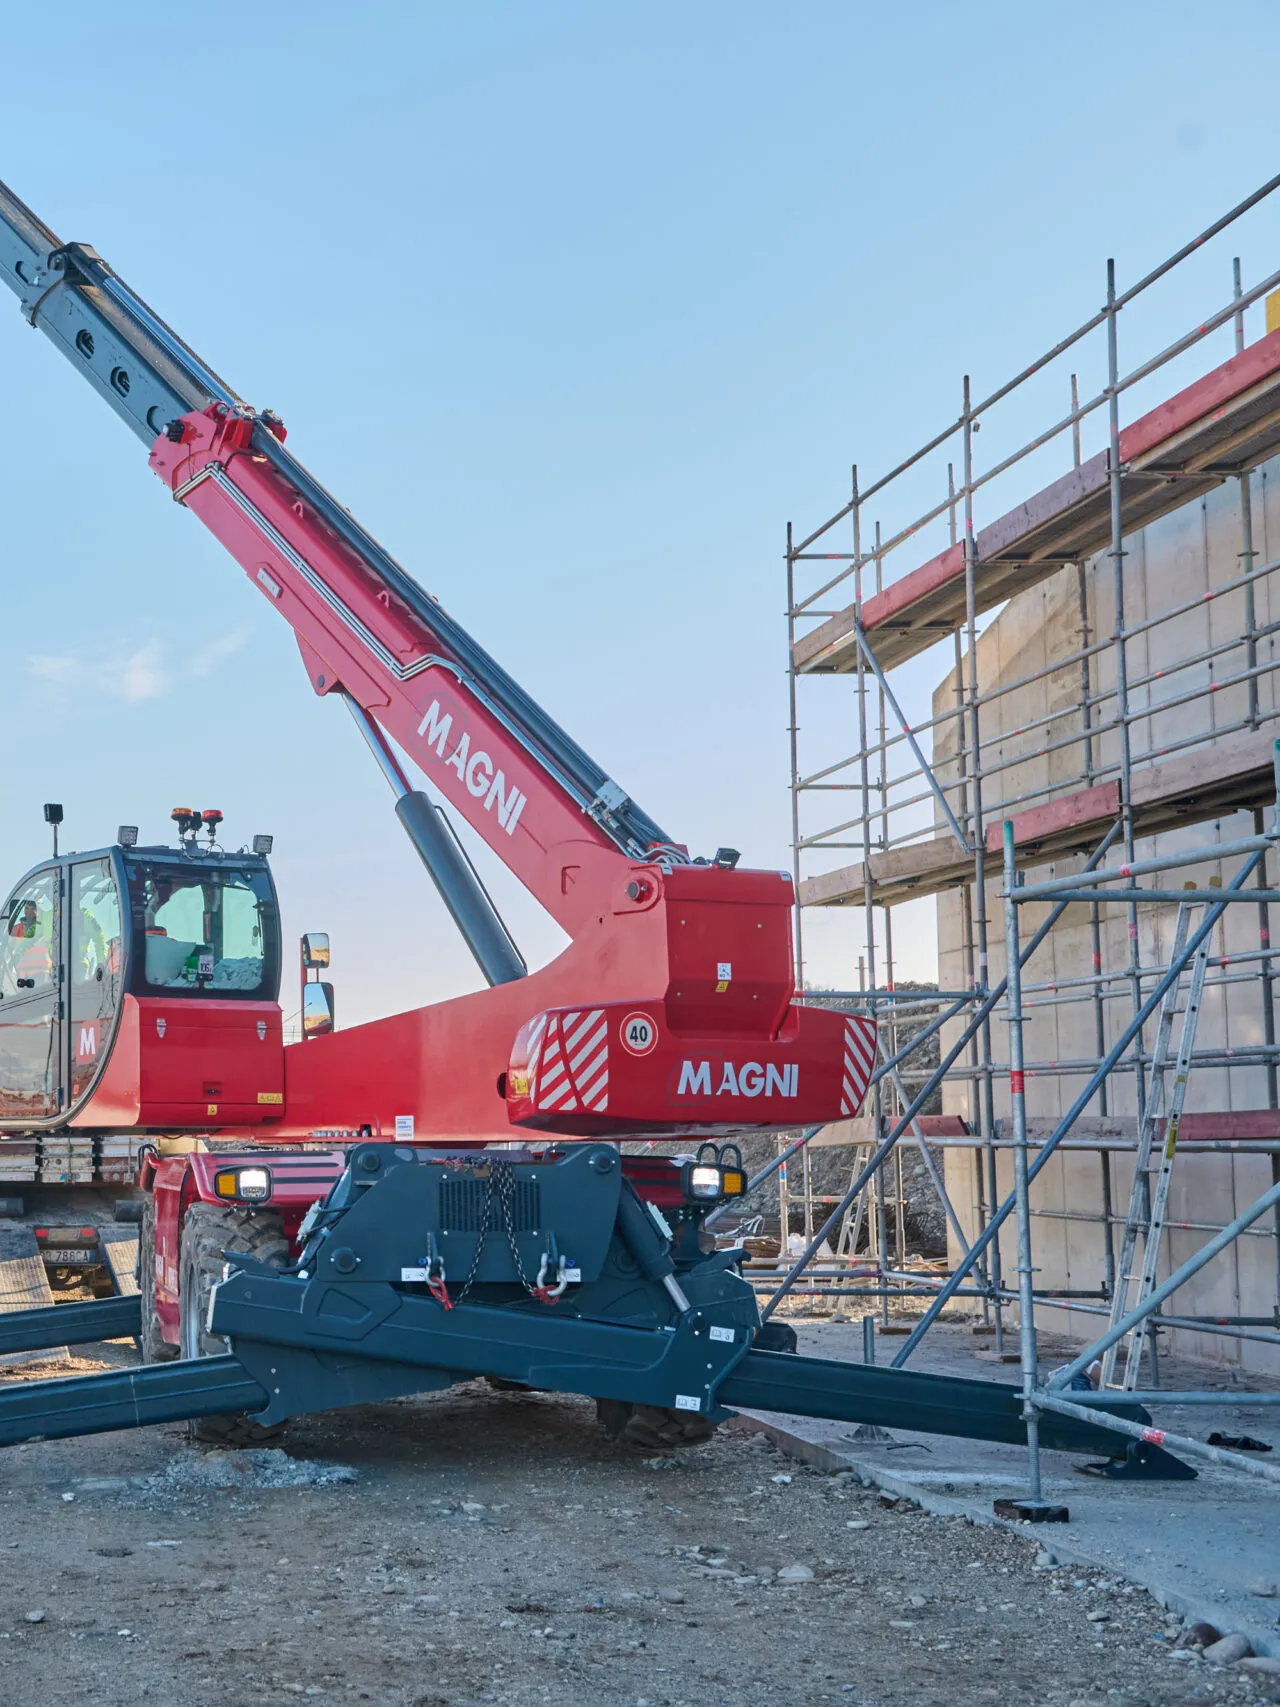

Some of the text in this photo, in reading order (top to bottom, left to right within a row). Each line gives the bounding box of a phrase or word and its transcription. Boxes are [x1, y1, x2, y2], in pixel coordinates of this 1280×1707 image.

[417, 699, 528, 837] MAGNI
[79, 1027, 96, 1056] M
[630, 1025, 648, 1042] 40
[677, 1060, 799, 1097] MAGNI
